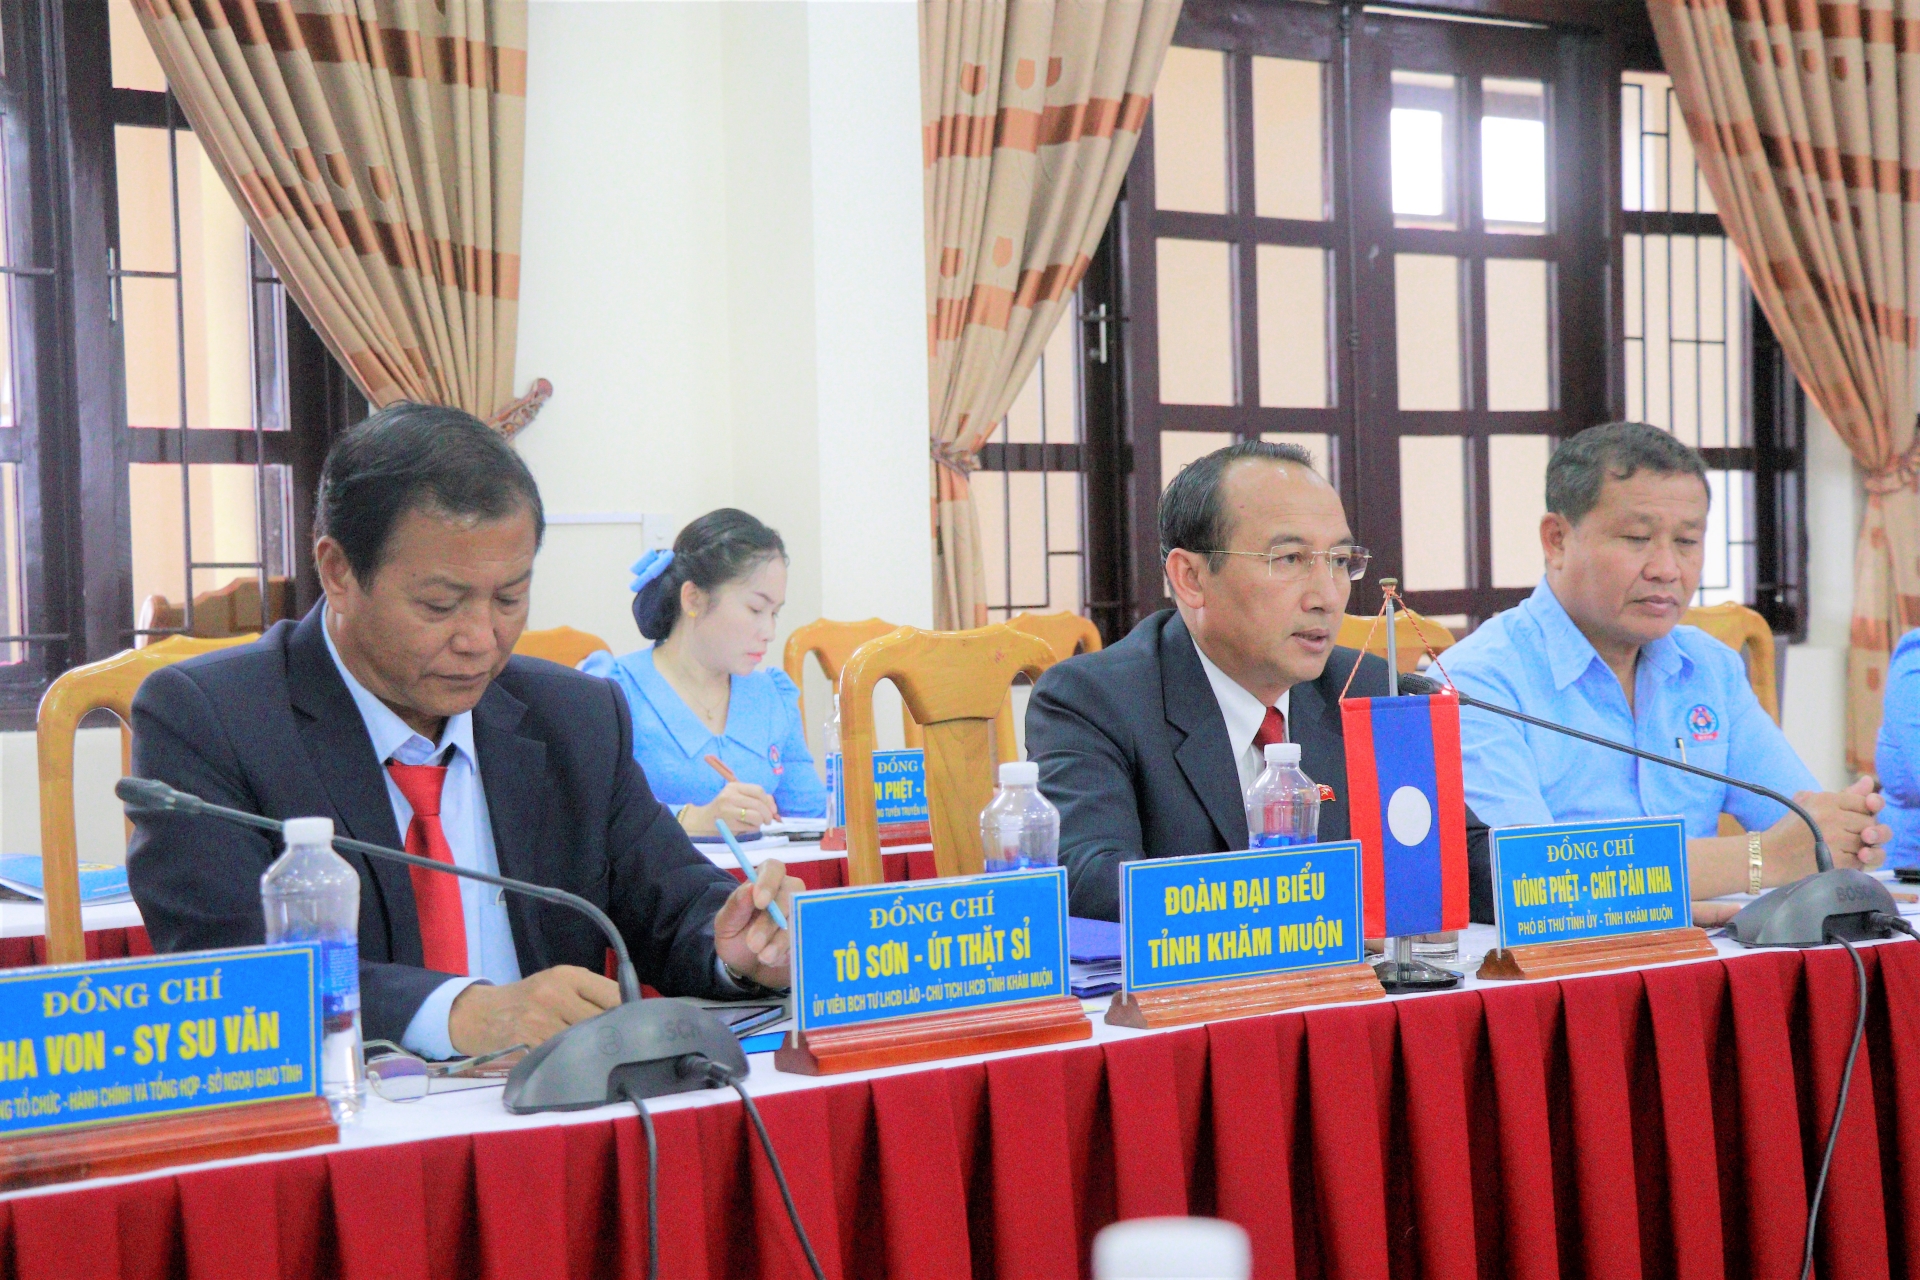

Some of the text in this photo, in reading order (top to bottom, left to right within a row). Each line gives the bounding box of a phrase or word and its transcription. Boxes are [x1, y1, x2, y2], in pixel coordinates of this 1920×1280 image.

[885, 777, 914, 803] PHỆT
[1546, 833, 1635, 863] ĐỒNG CHÍ
[869, 890, 995, 929] ĐỒNG CHÍ
[1164, 862, 1325, 916] ĐOÀN ĐẠI BIỂU
[1512, 873, 1548, 907] VÔNG
[1549, 869, 1579, 909] PHỆT
[1590, 865, 1617, 899] CHÍT
[1619, 863, 1645, 897] PĂN
[1646, 865, 1673, 894] NHA
[1148, 915, 1343, 968] TỈNH KHĂM MUỘN
[1518, 917, 1536, 936] PHÓ
[1538, 915, 1547, 934] BÍ
[1548, 915, 1565, 932] THƯ
[1566, 911, 1585, 931] TỈNH
[1586, 909, 1598, 928] ỦY
[1604, 907, 1623, 926] TỈNH
[1625, 906, 1648, 924] KHĂM
[1649, 903, 1673, 923] MUỘN
[833, 940, 860, 982] TÔ
[866, 939, 909, 978] SƠN
[928, 931, 953, 970] ÚT
[957, 924, 1006, 971] THẶT
[1011, 916, 1031, 960] SỈ
[43, 968, 223, 1018] ĐỒNG CHÍ
[813, 993, 825, 1017] ỦY
[826, 993, 846, 1014] VIÊN
[847, 994, 866, 1012] BCH
[903, 984, 921, 1005] LÀO
[926, 978, 943, 1002] CHỦ
[944, 981, 963, 1002] TỊCH
[987, 971, 1005, 993] TỈNH
[1007, 970, 1029, 991] KHĂM
[1030, 966, 1053, 990] MUỘN
[44, 1030, 105, 1076] VON
[133, 1023, 171, 1066] SY
[178, 1017, 216, 1060] SU
[223, 1006, 279, 1055] VĂN
[14, 1086, 30, 1118] TỔ
[69, 1085, 98, 1111] HÀNH
[100, 1081, 132, 1108] CHÍNH
[134, 1078, 149, 1103] VÀ
[149, 1069, 178, 1100] TỔNG
[180, 1074, 200, 1100] HỢP
[208, 1066, 223, 1094] SỞ
[223, 1070, 254, 1093] NGOẠI
[255, 1066, 279, 1088] GIAO
[280, 1058, 303, 1083] TỈNH
